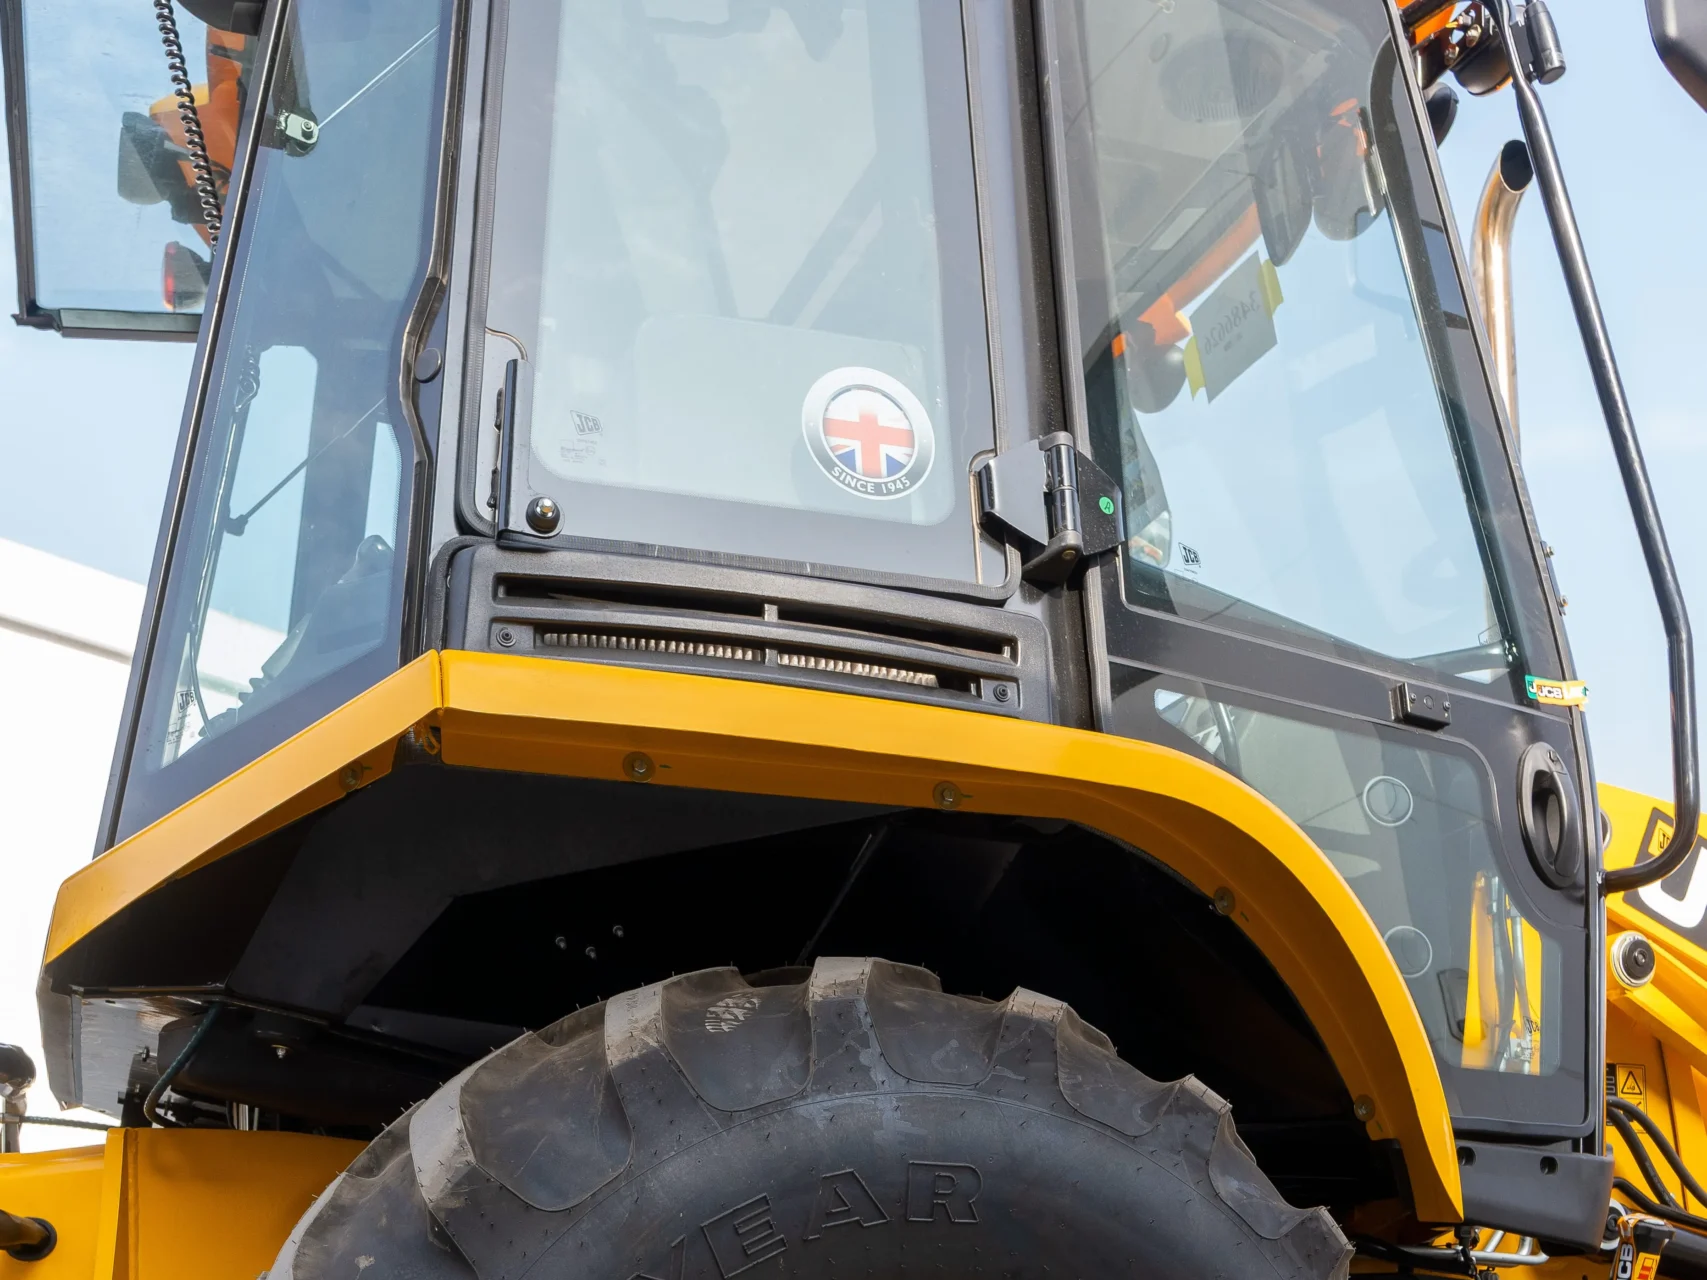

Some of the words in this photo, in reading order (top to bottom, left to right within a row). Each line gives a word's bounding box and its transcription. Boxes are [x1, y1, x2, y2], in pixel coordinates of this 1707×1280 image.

[575, 413, 601, 433] JCB
[831, 466, 876, 494] SINCE
[880, 476, 911, 494] 1945
[1181, 546, 1200, 563] JCB
[179, 691, 195, 710] JCB
[1537, 684, 1564, 699] JCB
